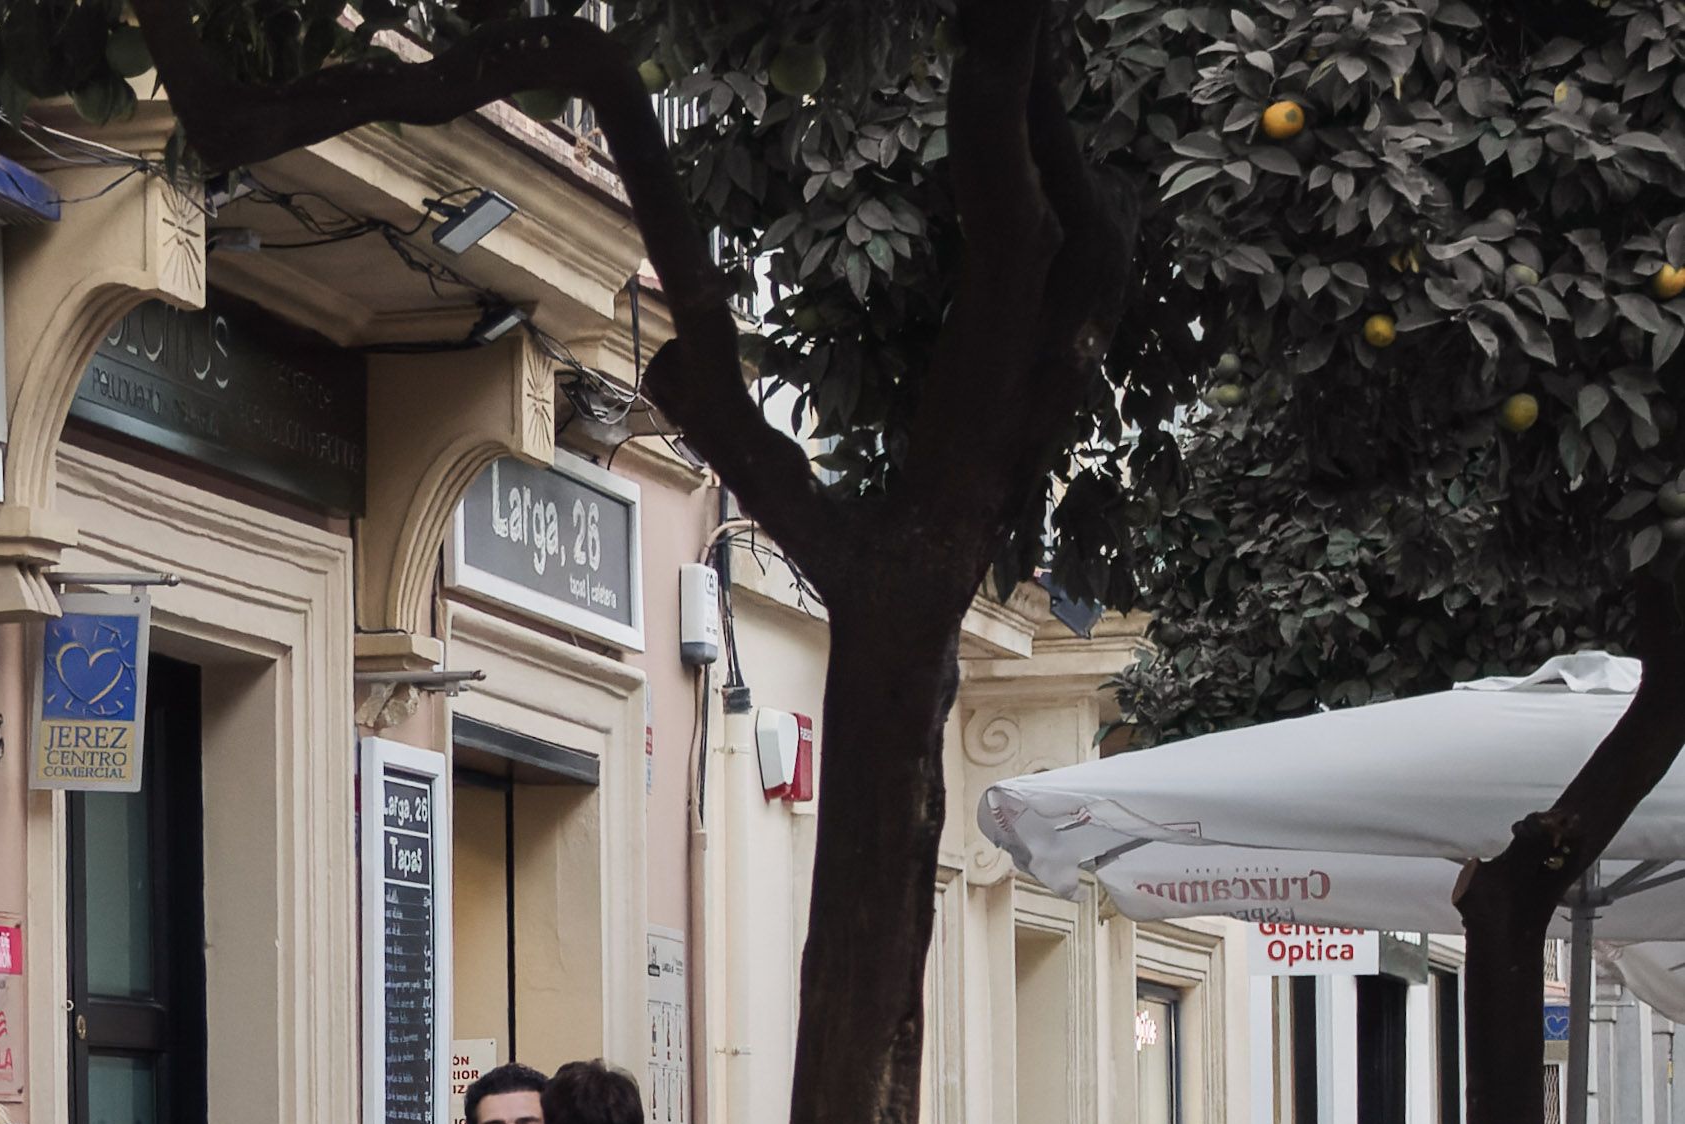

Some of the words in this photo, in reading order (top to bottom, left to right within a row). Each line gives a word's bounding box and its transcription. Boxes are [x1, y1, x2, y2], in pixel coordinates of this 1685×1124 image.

[492, 458, 566, 576] Larga,
[572, 499, 601, 573] 26
[45, 725, 128, 750] JEREZ
[46, 750, 128, 766] CENTRO
[43, 766, 126, 779] COMERCIAL
[415, 796, 428, 822] 26
[389, 836, 423, 878] Tapas
[1267, 939, 1354, 967] Optica
